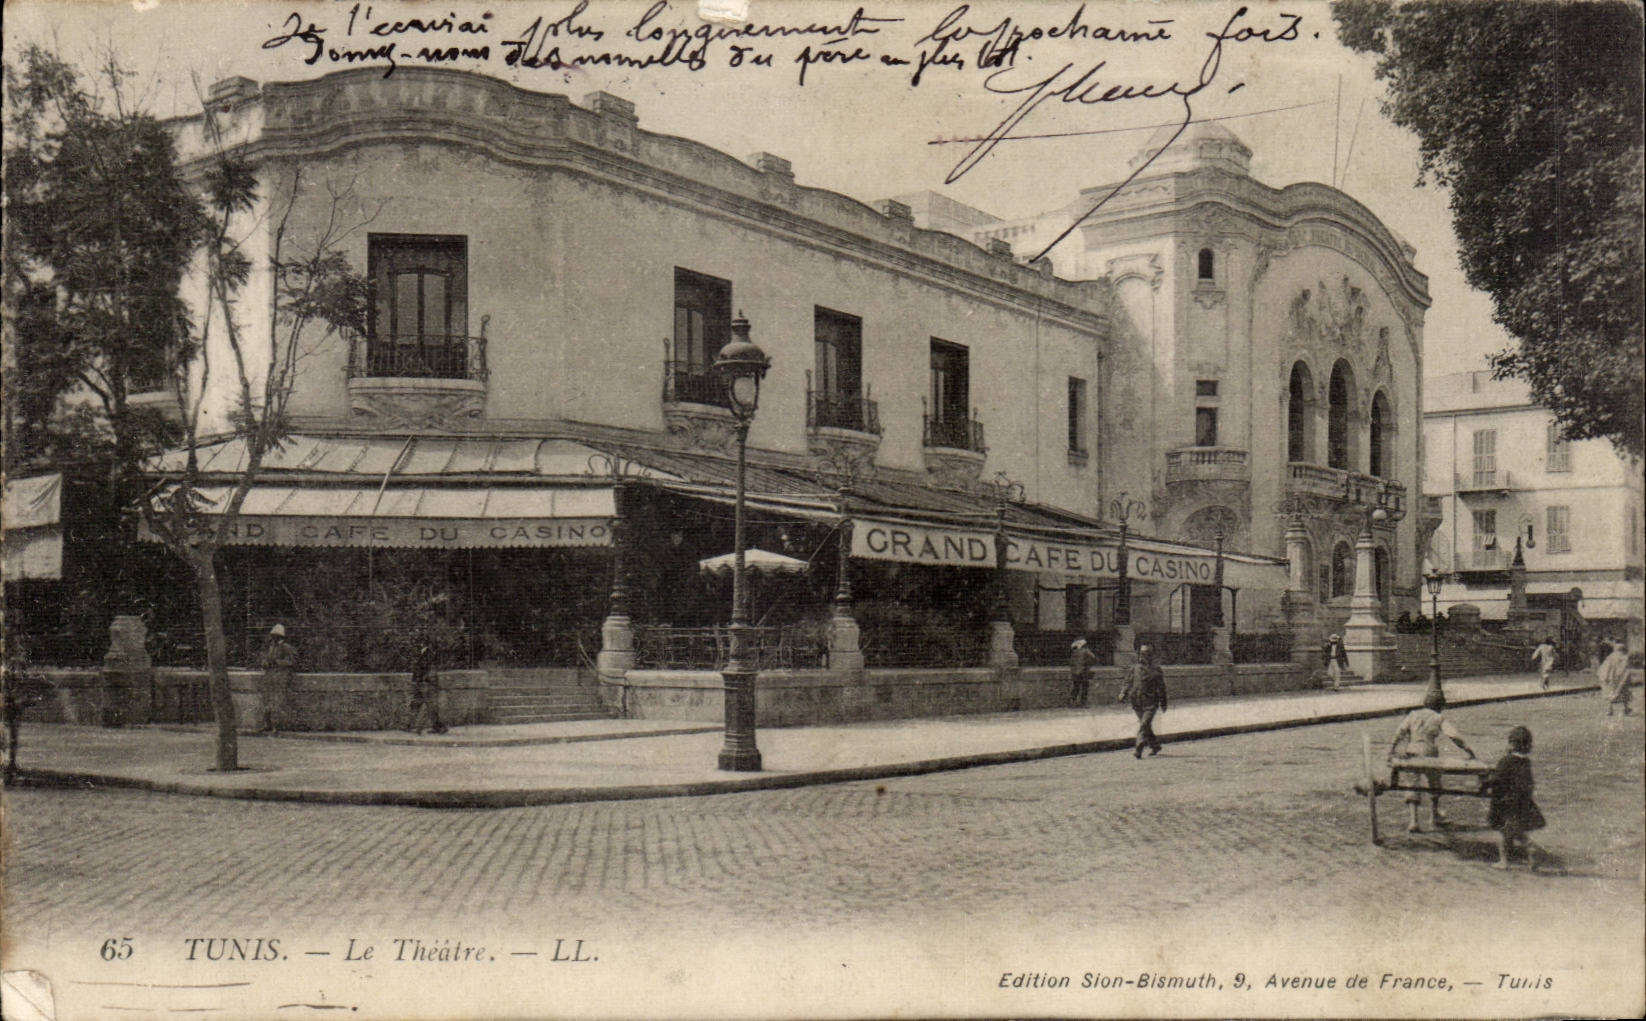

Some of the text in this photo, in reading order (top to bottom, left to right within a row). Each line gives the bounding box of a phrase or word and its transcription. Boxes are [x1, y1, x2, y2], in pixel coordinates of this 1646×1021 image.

[519, 0, 605, 66] plus
[302, 525, 391, 541] CAFE
[420, 527, 459, 542] DU
[490, 525, 606, 540] CASINO
[866, 527, 1211, 581] GRAND CAFE DU CASINO
